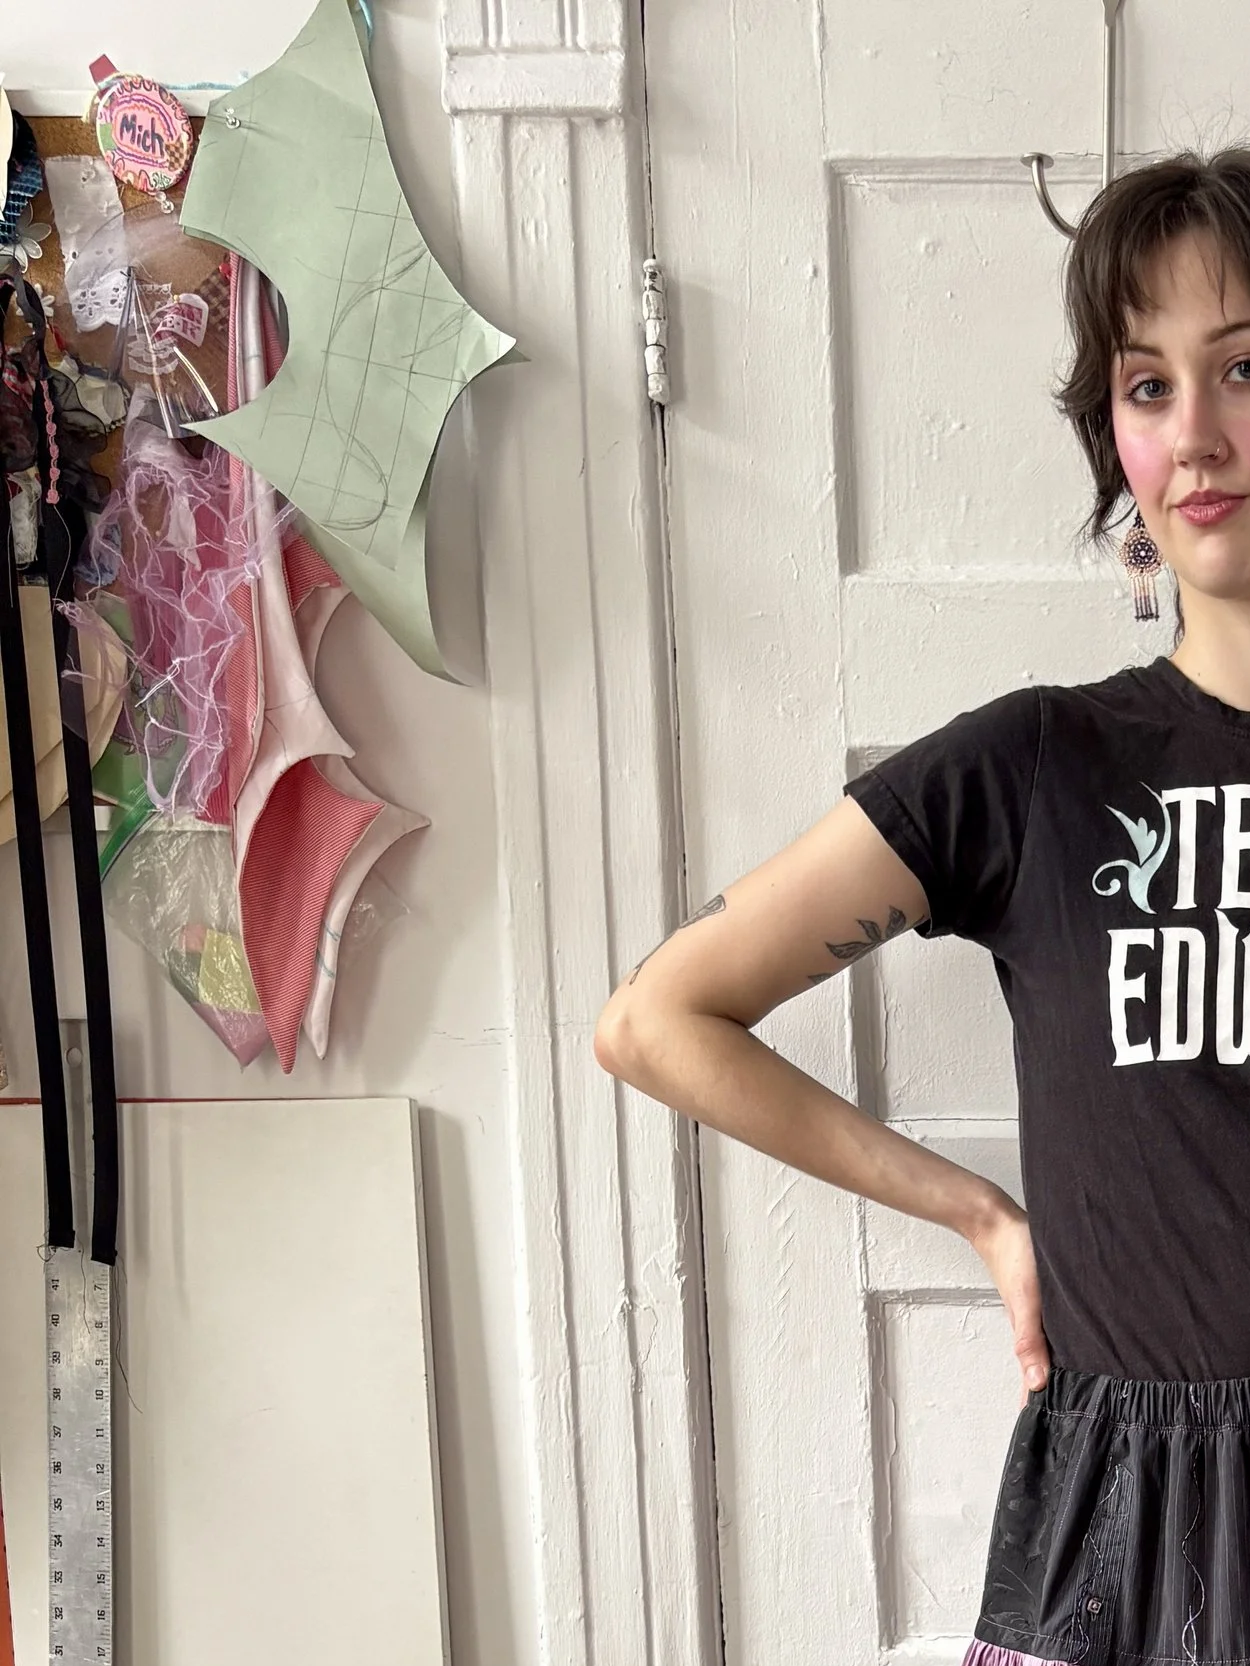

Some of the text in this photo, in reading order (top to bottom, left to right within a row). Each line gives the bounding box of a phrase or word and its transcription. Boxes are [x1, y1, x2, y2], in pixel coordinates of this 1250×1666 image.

[121, 113, 164, 158] Mich
[52, 1279, 60, 1291] 41
[94, 1284, 103, 1292] 7
[51, 1314, 60, 1327] 40
[52, 1352, 60, 1364] 39
[53, 1388, 61, 1401] 38
[96, 1389, 104, 1400] 10
[96, 1428, 104, 1438] 11
[96, 1463, 104, 1474] 12
[54, 1498, 62, 1511] 35
[97, 1500, 104, 1511] 13
[54, 1535, 62, 1547] 34
[97, 1537, 105, 1548] 14
[54, 1571, 62, 1583] 33
[97, 1573, 105, 1584] 15
[55, 1607, 63, 1620] 32
[97, 1609, 105, 1620] 16
[55, 1645, 63, 1656] 31
[97, 1647, 105, 1657] 17
